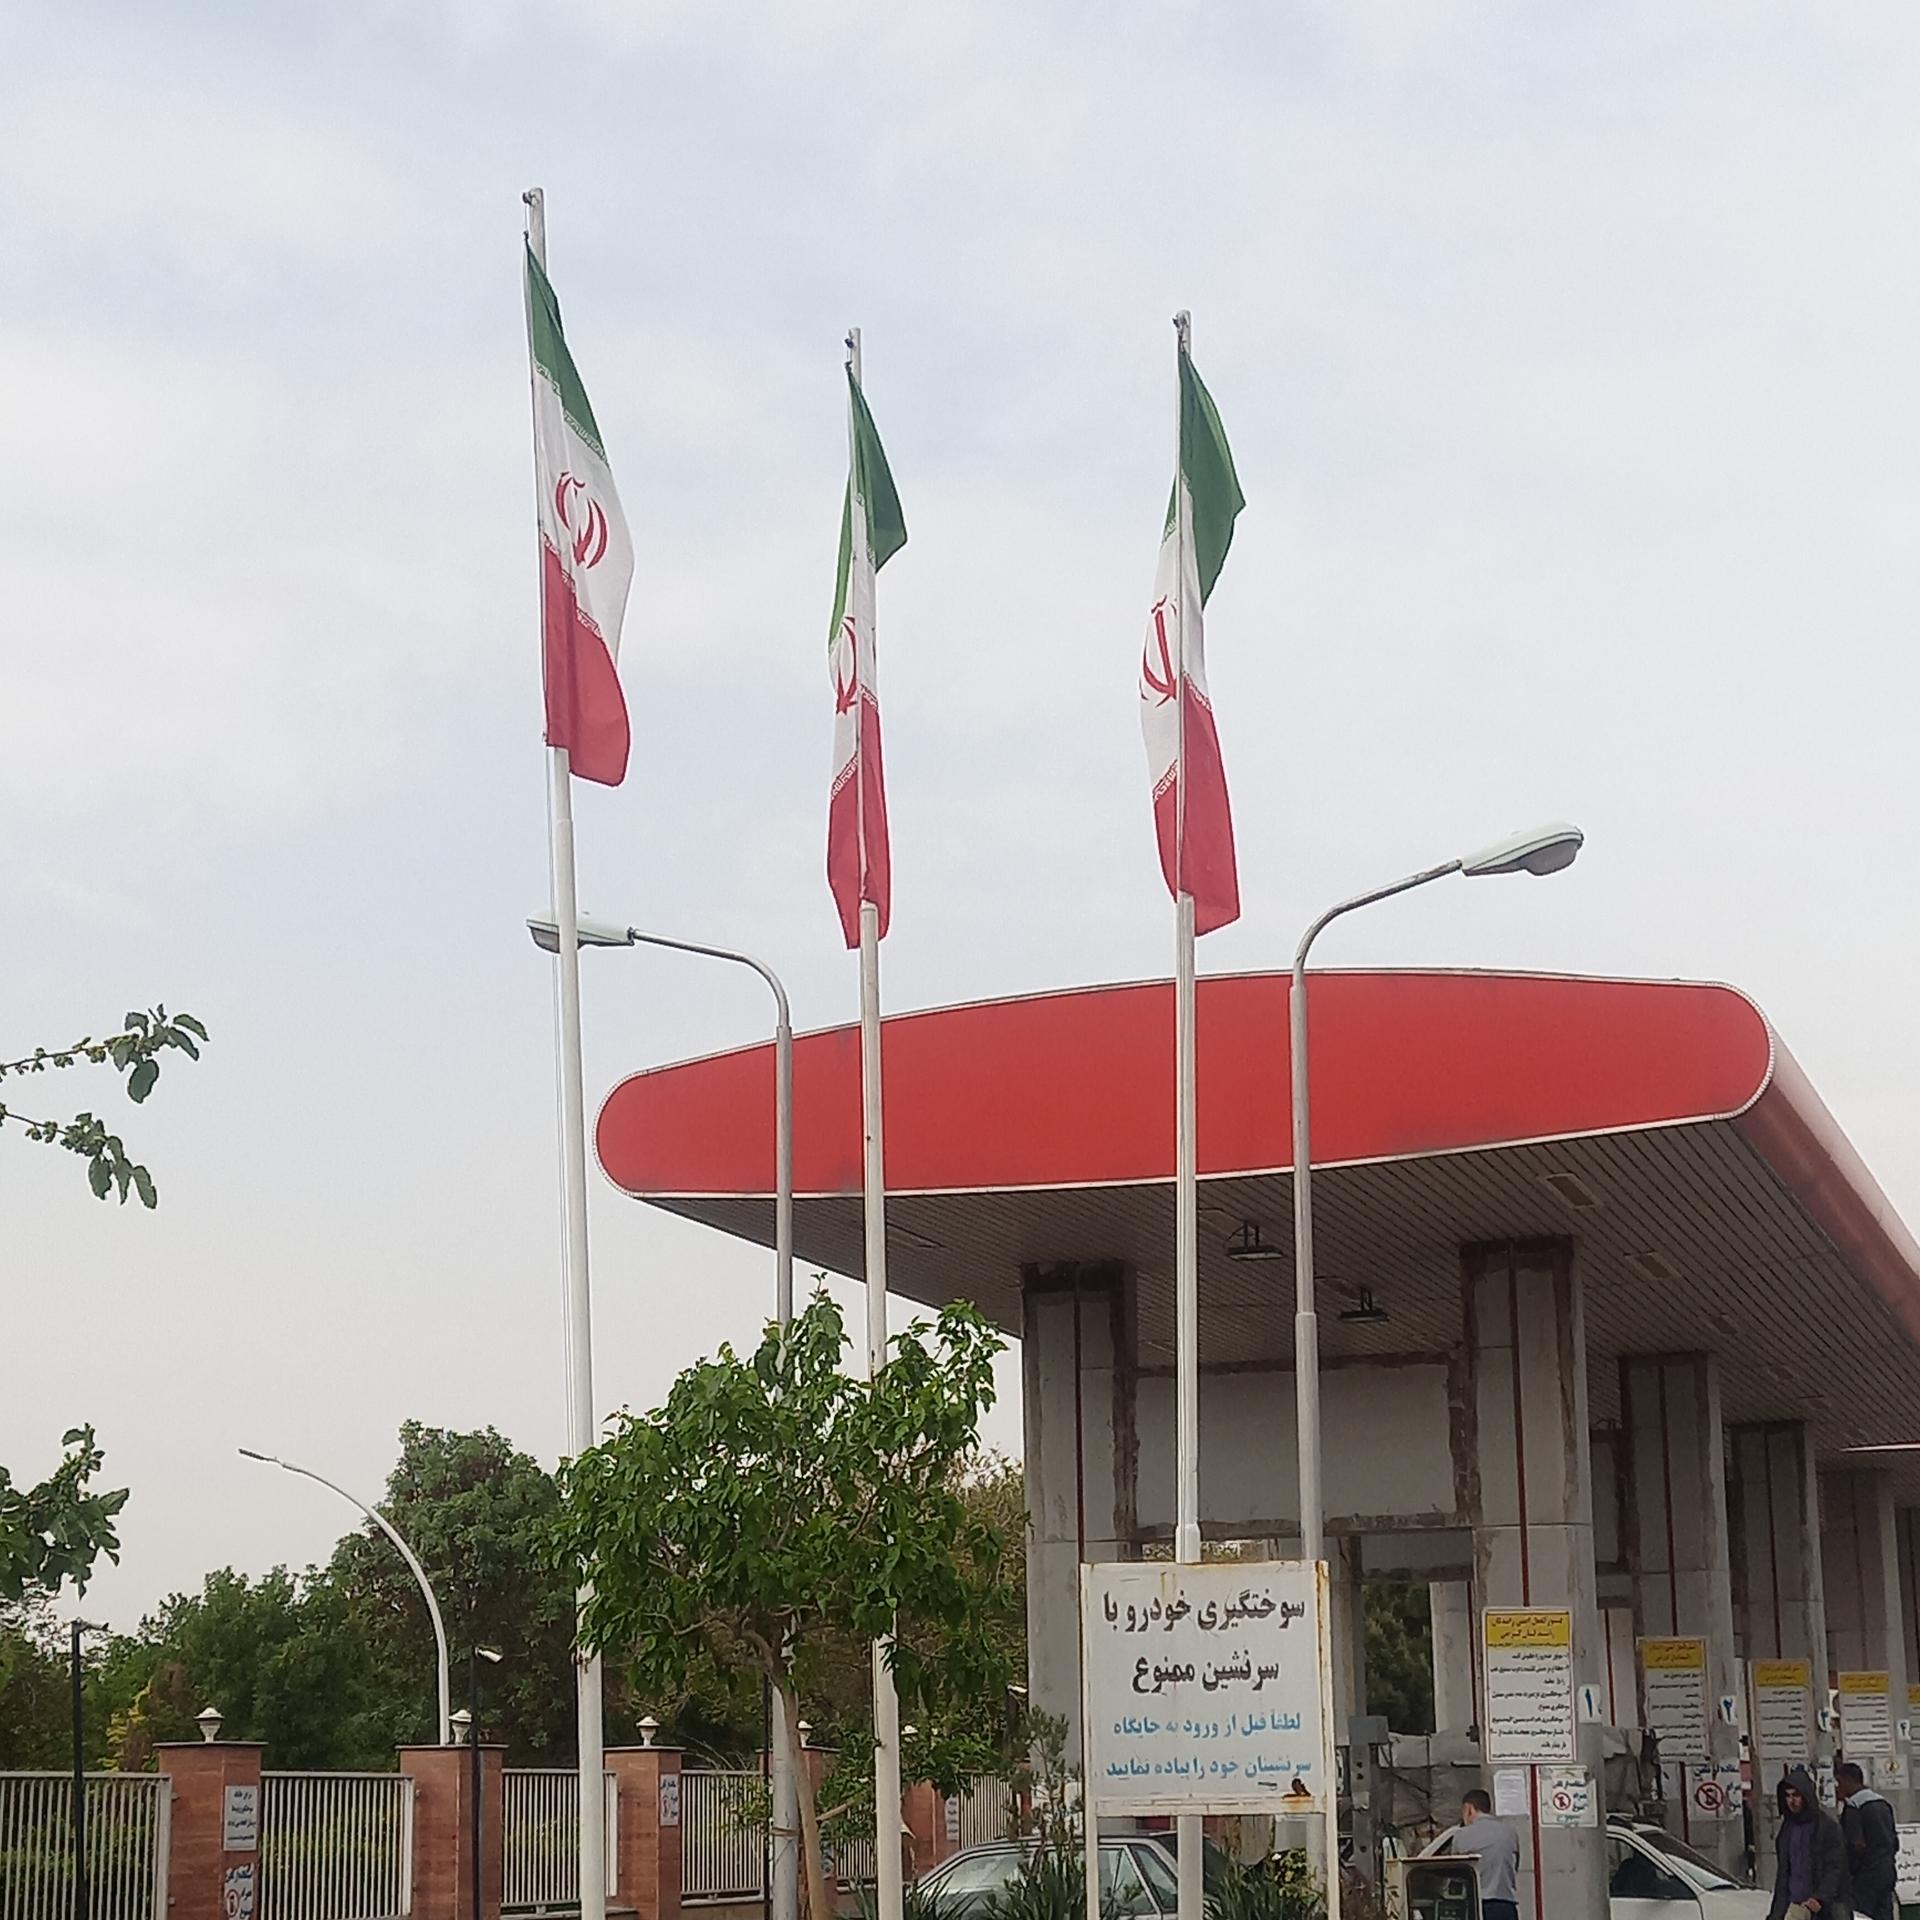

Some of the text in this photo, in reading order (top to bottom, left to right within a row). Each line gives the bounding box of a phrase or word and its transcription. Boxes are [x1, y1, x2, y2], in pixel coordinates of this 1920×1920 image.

[1103, 1588, 1305, 1632] سوختگیری خودرو با
[1132, 1650, 1279, 1693] سرنشین ممنوع
[1184, 1719, 1218, 1738] ورود
[1224, 1713, 1236, 1737] از
[1241, 1713, 1267, 1736] قبل
[1154, 1756, 1189, 1780] پیاده
[1193, 1756, 1205, 1780] را
[1210, 1756, 1239, 1779] خود
[1245, 1755, 1312, 1778] سرنشینان
